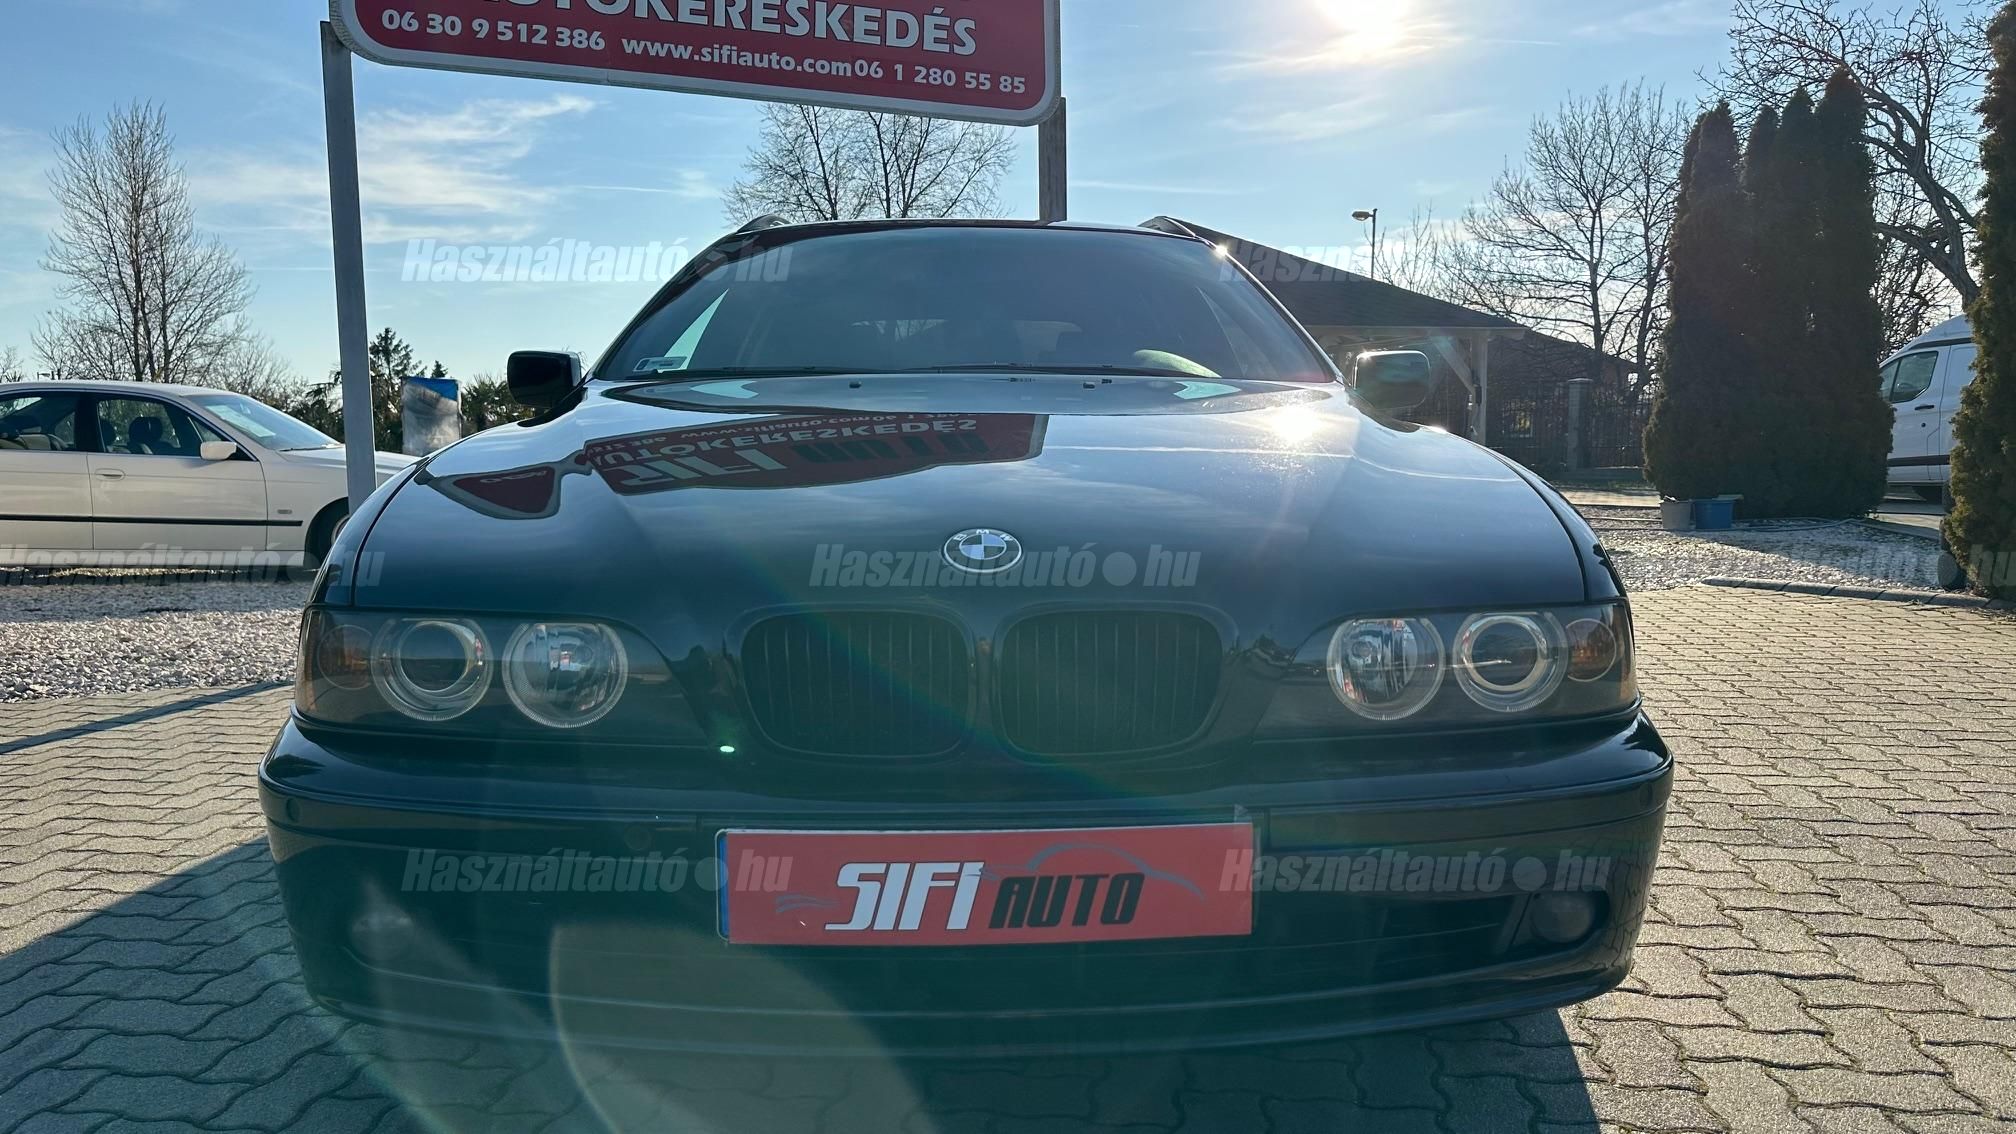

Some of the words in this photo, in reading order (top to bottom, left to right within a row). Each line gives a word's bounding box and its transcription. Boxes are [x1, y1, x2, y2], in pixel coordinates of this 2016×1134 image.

[381, 9, 419, 32] 06
[426, 13, 462, 36] 30
[471, 18, 490, 39] 9
[497, 20, 548, 45] 512
[555, 26, 606, 50] 386
[621, 38, 852, 77] www.sifiauto.com
[854, 59, 884, 79] 06
[894, 63, 904, 81] 1
[914, 65, 956, 87] 280
[964, 71, 992, 91] 55
[999, 75, 1026, 95] 85
[987, 872, 1145, 929] AUTO
